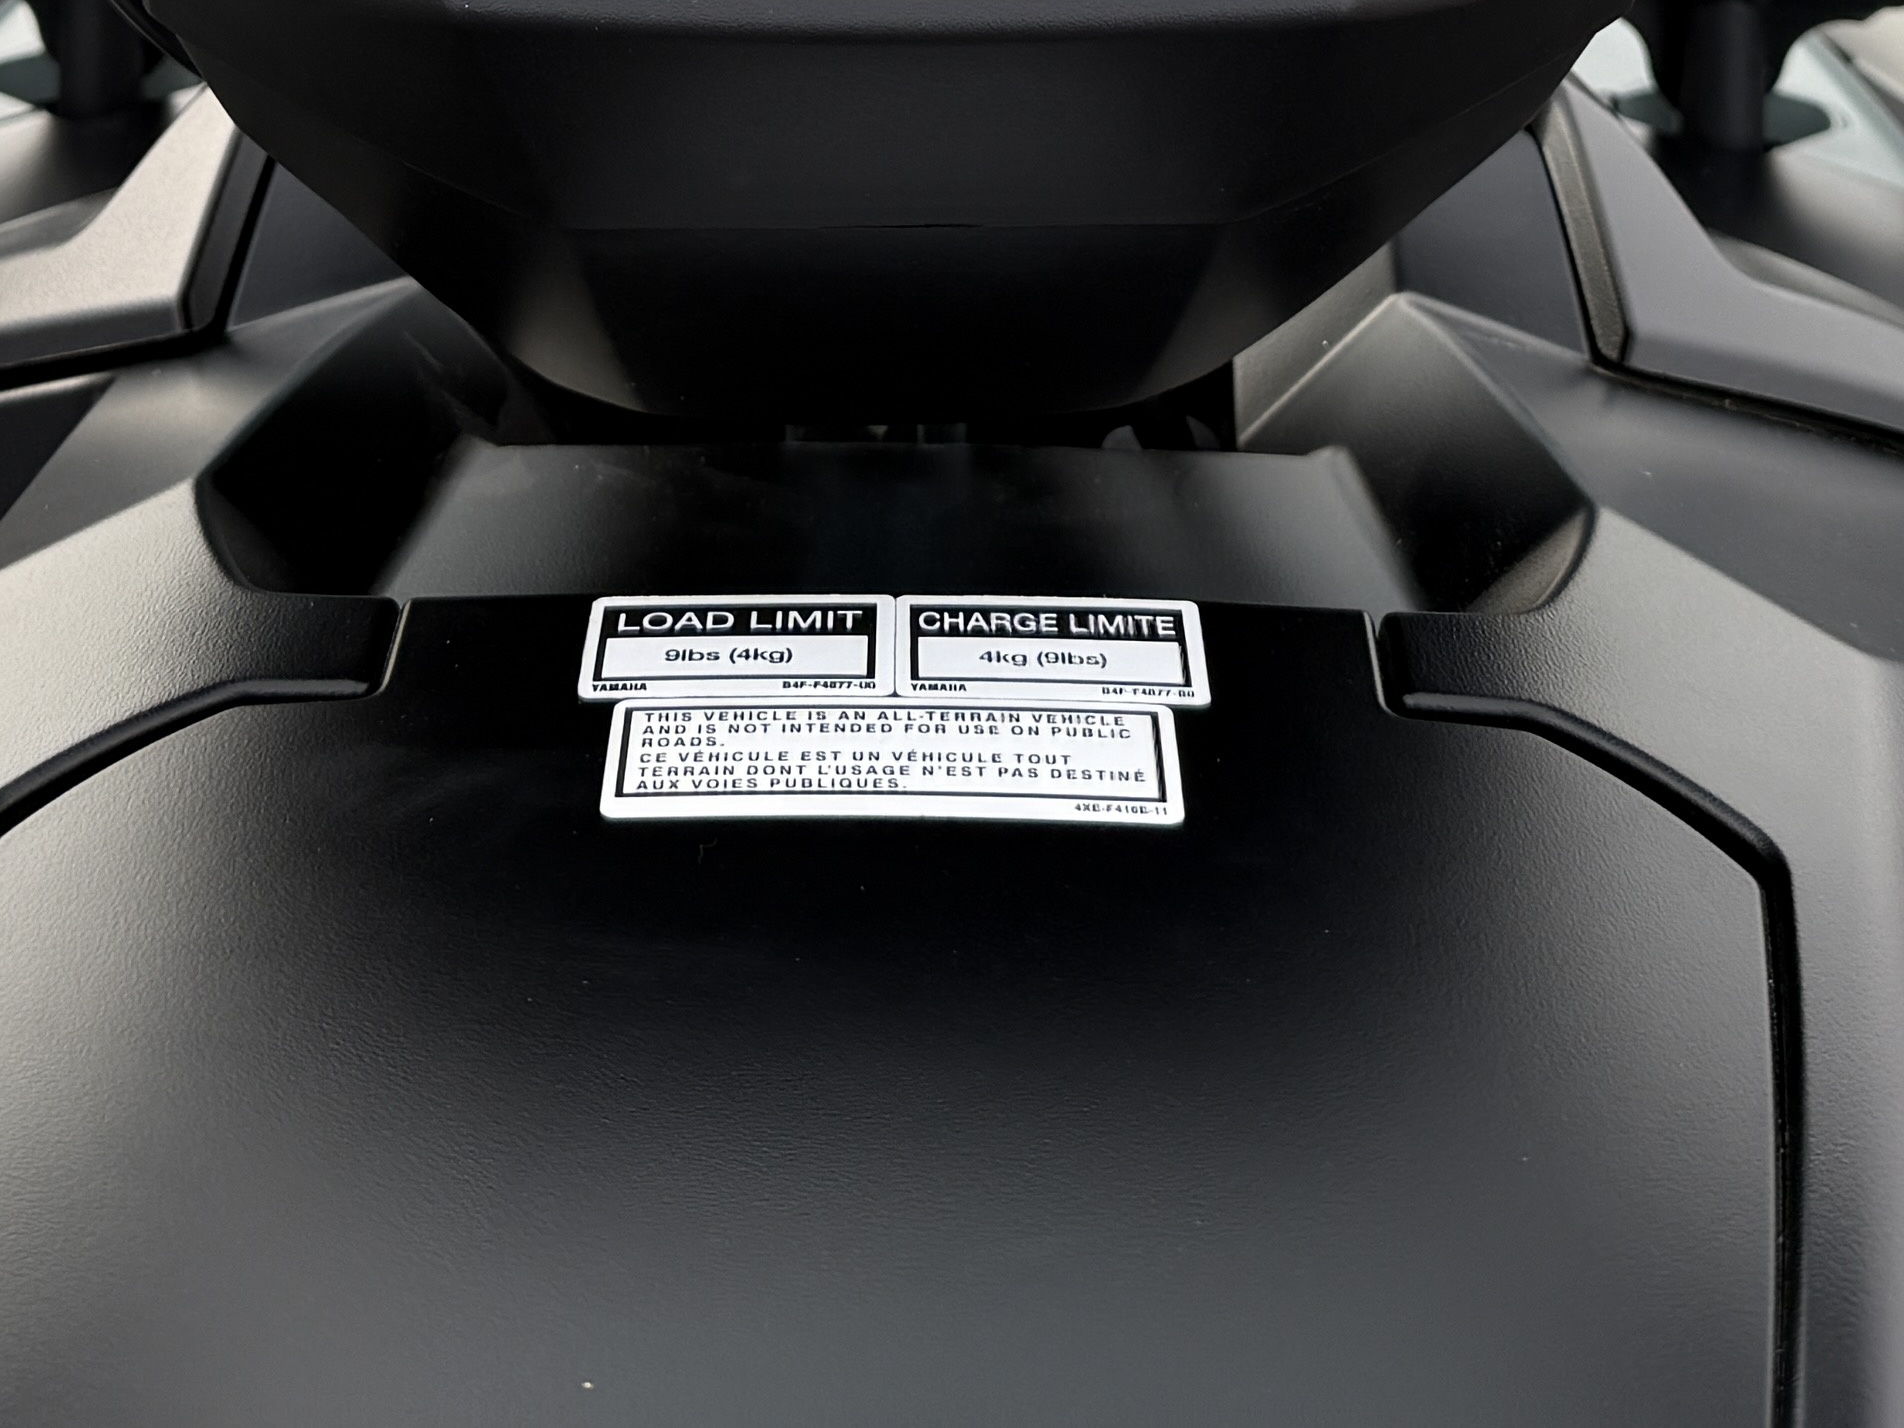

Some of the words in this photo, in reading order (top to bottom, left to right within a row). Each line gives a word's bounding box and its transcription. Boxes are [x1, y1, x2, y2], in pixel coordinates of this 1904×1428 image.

[617, 611, 735, 633] LOAD
[750, 610, 863, 632] LIMIT
[918, 611, 1059, 634] CHARGE
[1069, 614, 1176, 636] LIMITE
[664, 648, 721, 663] 9lbs
[728, 647, 794, 665] (4kg)
[979, 651, 1028, 667] 4kg
[1036, 651, 1107, 668] (9lbs)
[592, 682, 648, 692] YAMAHA
[910, 682, 967, 692] YAMAHA
[645, 712, 693, 722] THIS
[704, 711, 798, 721] VEHICLE
[808, 711, 827, 721] IS
[838, 711, 866, 721] AN
[877, 711, 1021, 724] ALL-TERRAIN
[1032, 714, 1125, 727] VEHICLE
[643, 725, 686, 735] AND
[698, 724, 717, 734] IS
[728, 723, 771, 734] NOT
[782, 723, 893, 734] INTENDED
[904, 723, 947, 734] FOR
[958, 725, 1000, 736] USE
[1011, 726, 1040, 737] ON
[1051, 727, 1131, 739] PUBLIC
[641, 737, 725, 748] ROADS.
[640, 753, 668, 763] CE
[678, 750, 789, 762] VÉHICULE
[800, 751, 841, 762] EST
[853, 751, 881, 762] UN
[891, 749, 1003, 763] VÉHICULE
[1014, 753, 1072, 765] TOUT
[638, 766, 735, 777] TERRAIN
[746, 765, 807, 776] DONT
[818, 764, 911, 776] L'USAGE
[922, 765, 987, 777] N'EST
[998, 767, 1039, 778] PAS
[1050, 769, 1146, 782] DESTINÉ
[636, 779, 680, 790] AUX
[692, 778, 758, 789] VOIES
[769, 777, 907, 789] PUBLIQUES.
